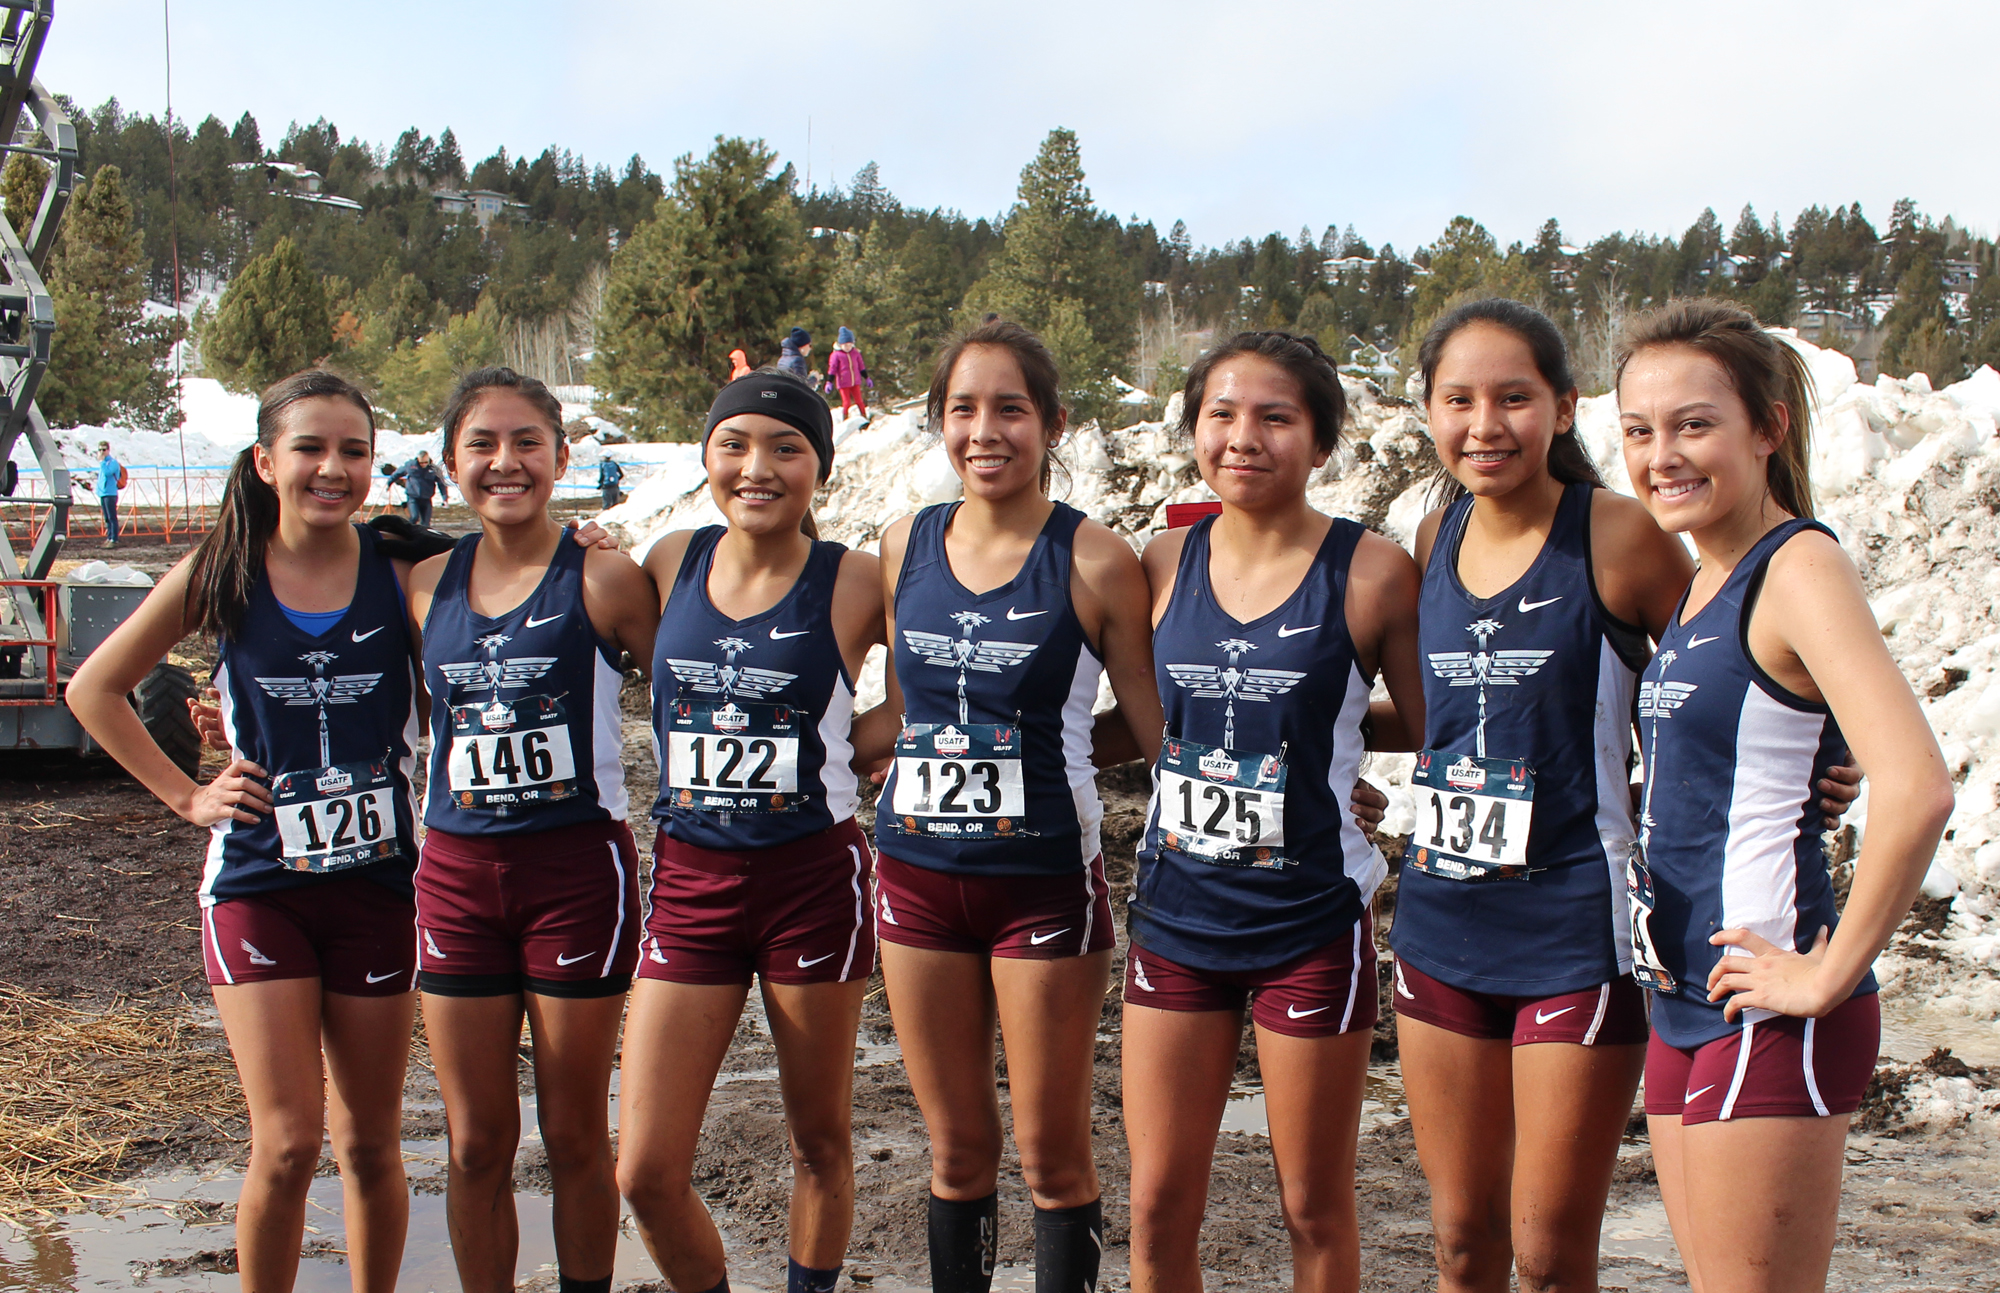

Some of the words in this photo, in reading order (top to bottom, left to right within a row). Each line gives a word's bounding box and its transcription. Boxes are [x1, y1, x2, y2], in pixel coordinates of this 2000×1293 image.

[717, 713, 745, 723] USATF
[938, 737, 965, 746] USATF
[466, 731, 554, 786] 146
[690, 737, 777, 789] 122
[1203, 759, 1234, 771] USATF
[321, 776, 349, 787] USATF
[1451, 769, 1481, 779] USATF
[913, 761, 1002, 814] 123
[486, 793, 519, 804] BEND,
[522, 790, 539, 800] OR
[703, 796, 737, 809] BEND,
[740, 798, 757, 808] OR
[1179, 780, 1262, 845] 125
[298, 793, 382, 851] 126
[927, 822, 962, 834] BEND,
[965, 822, 984, 833] OR
[1430, 792, 1508, 859] 134
[322, 854, 355, 868] BEND,
[356, 850, 371, 860] OR
[1222, 850, 1241, 860] OR
[1435, 858, 1467, 876] BEND,
[980, 1216, 993, 1277] 2XU
